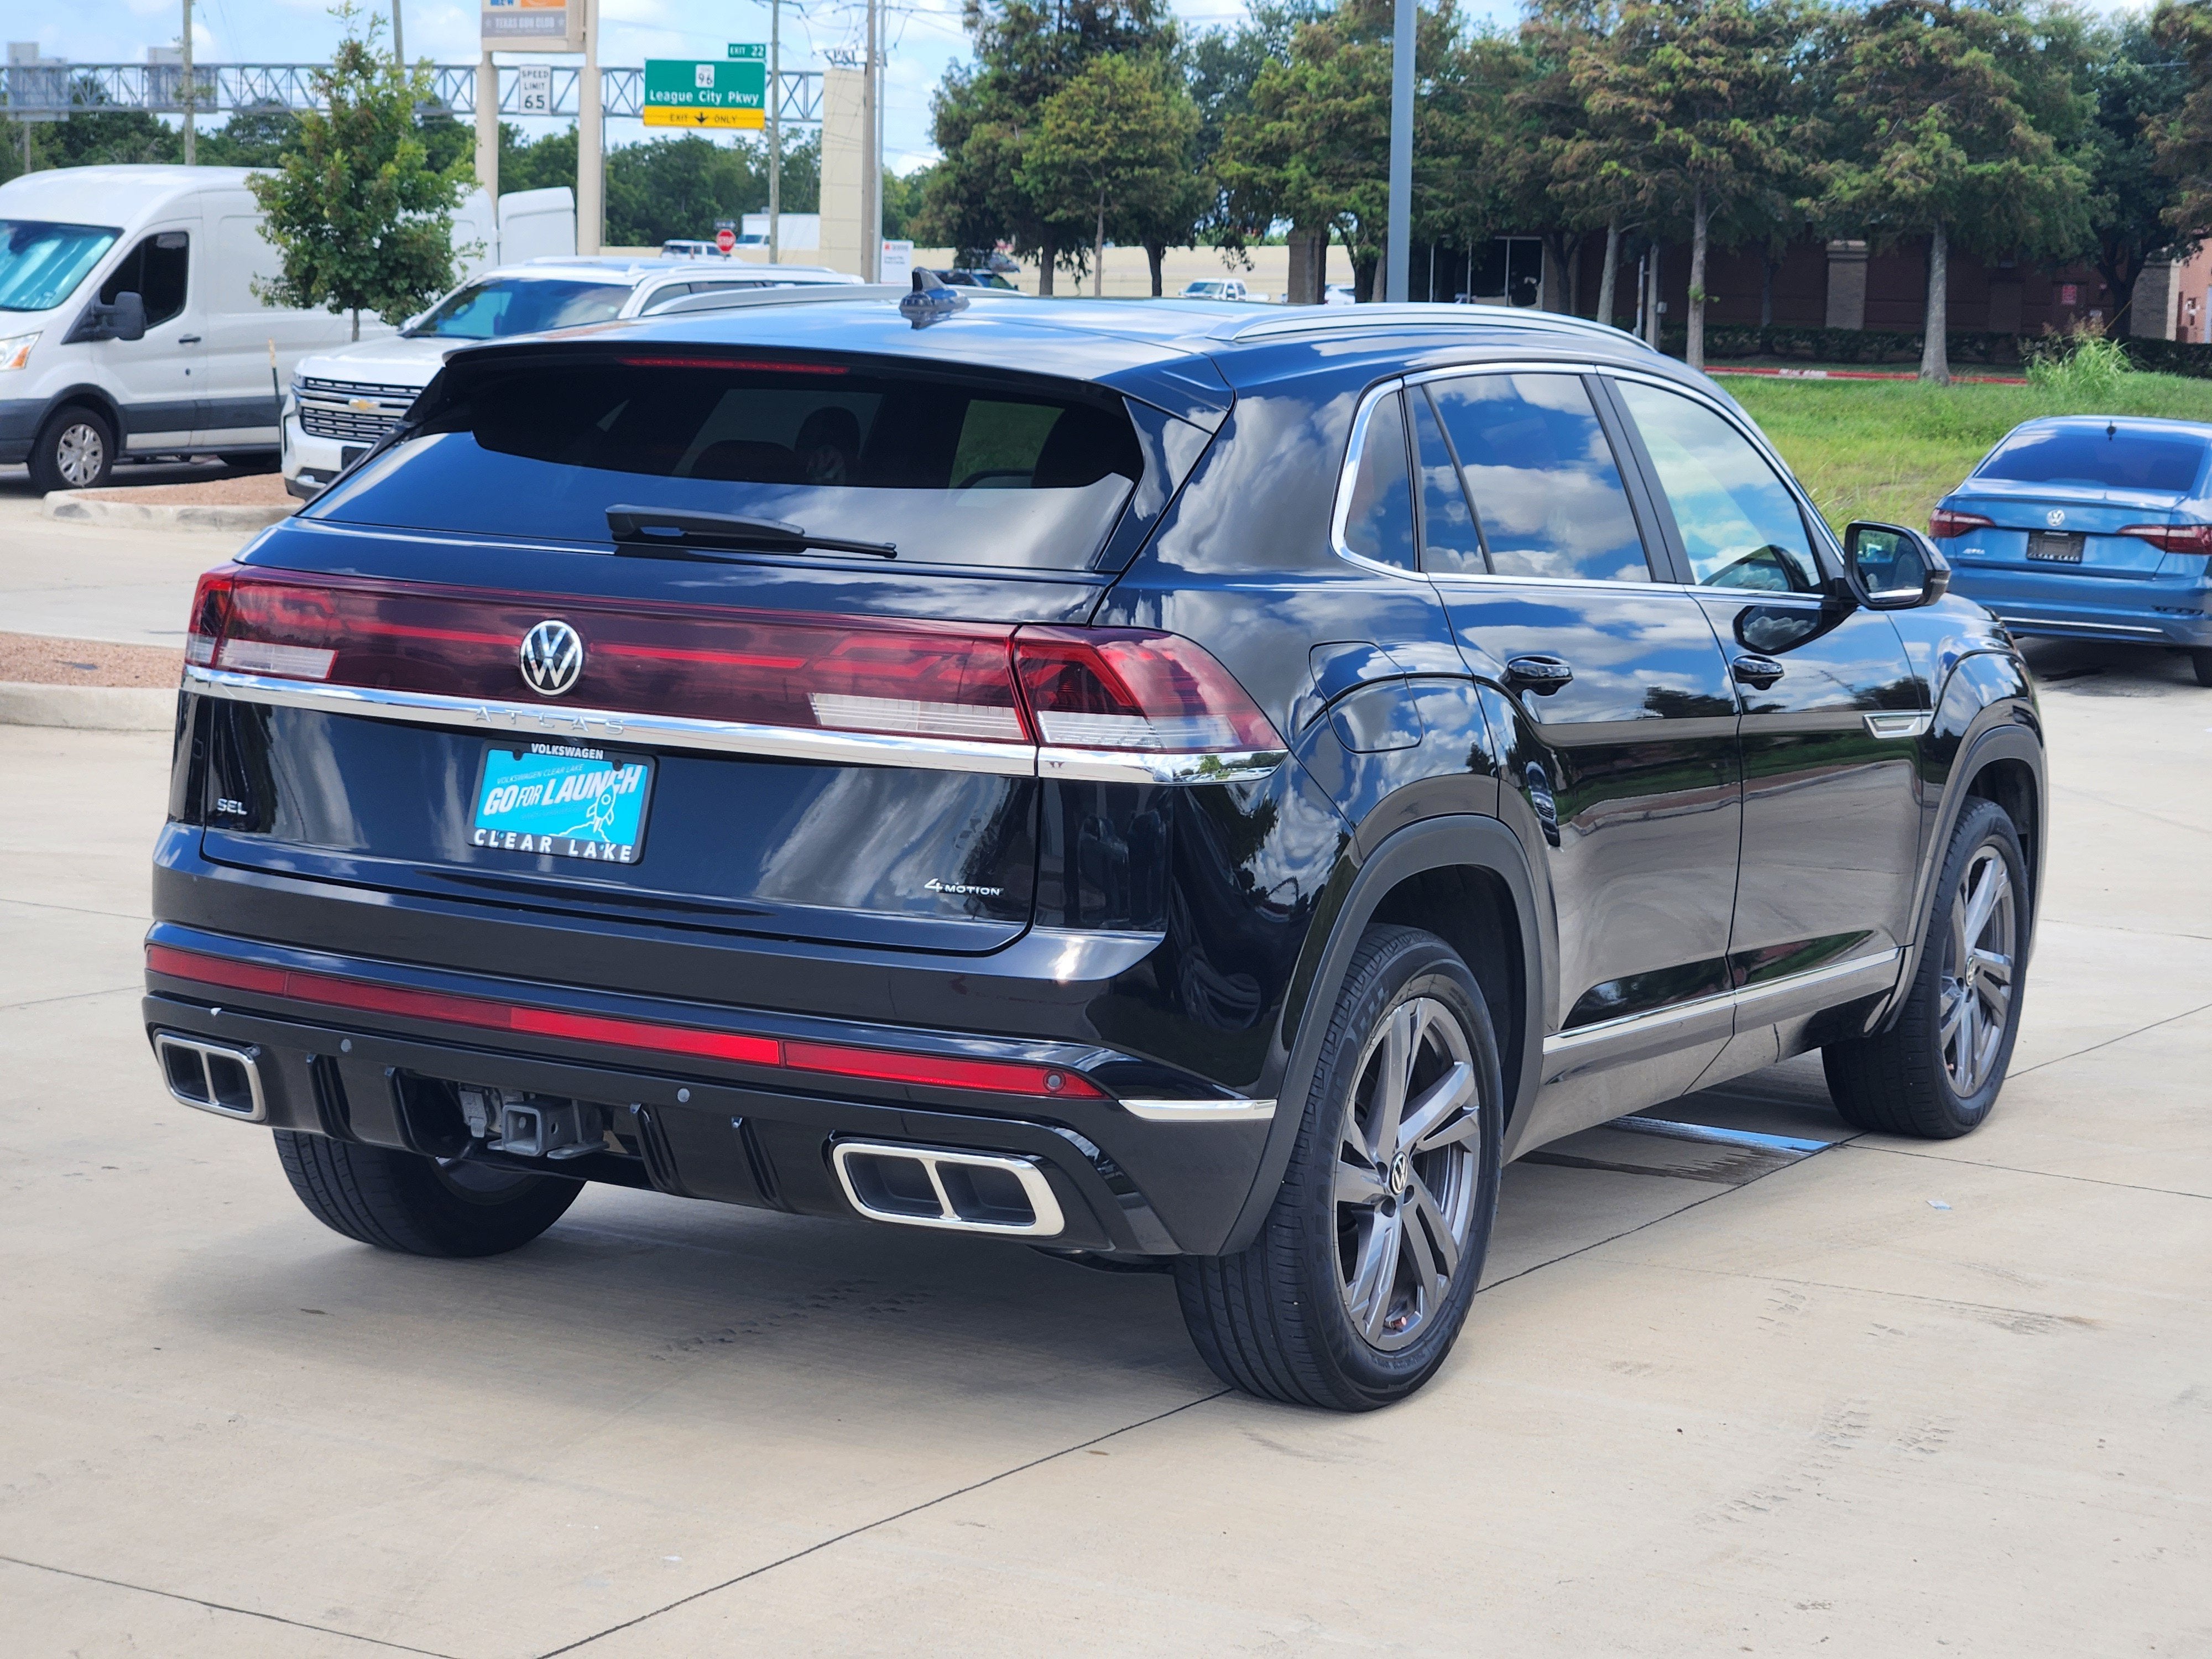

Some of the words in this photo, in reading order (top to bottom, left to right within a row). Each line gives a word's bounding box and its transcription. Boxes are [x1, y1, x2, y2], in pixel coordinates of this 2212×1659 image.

[729, 46, 745, 55] EXIT
[751, 45, 765, 57] 22
[524, 82, 545, 90] LIMIT
[698, 72, 713, 85] 96
[525, 94, 545, 109] 65
[649, 89, 693, 105] League
[698, 90, 722, 106] City
[728, 90, 759, 106] Pkwy
[670, 114, 688, 122] EXIT
[714, 114, 737, 123] ONLY
[476, 706, 624, 735] ATLAS
[531, 743, 604, 760] VOLKSWAGEN
[543, 766, 566, 777] CLEAR
[566, 763, 585, 773] LAKE
[483, 785, 519, 816] GO
[515, 784, 543, 808] FOR
[541, 765, 644, 806] LAUNCH
[217, 798, 248, 816] SEL
[474, 828, 552, 853] CLEAR
[568, 839, 632, 862] LAKE
[924, 878, 1001, 896] 4MOTION
